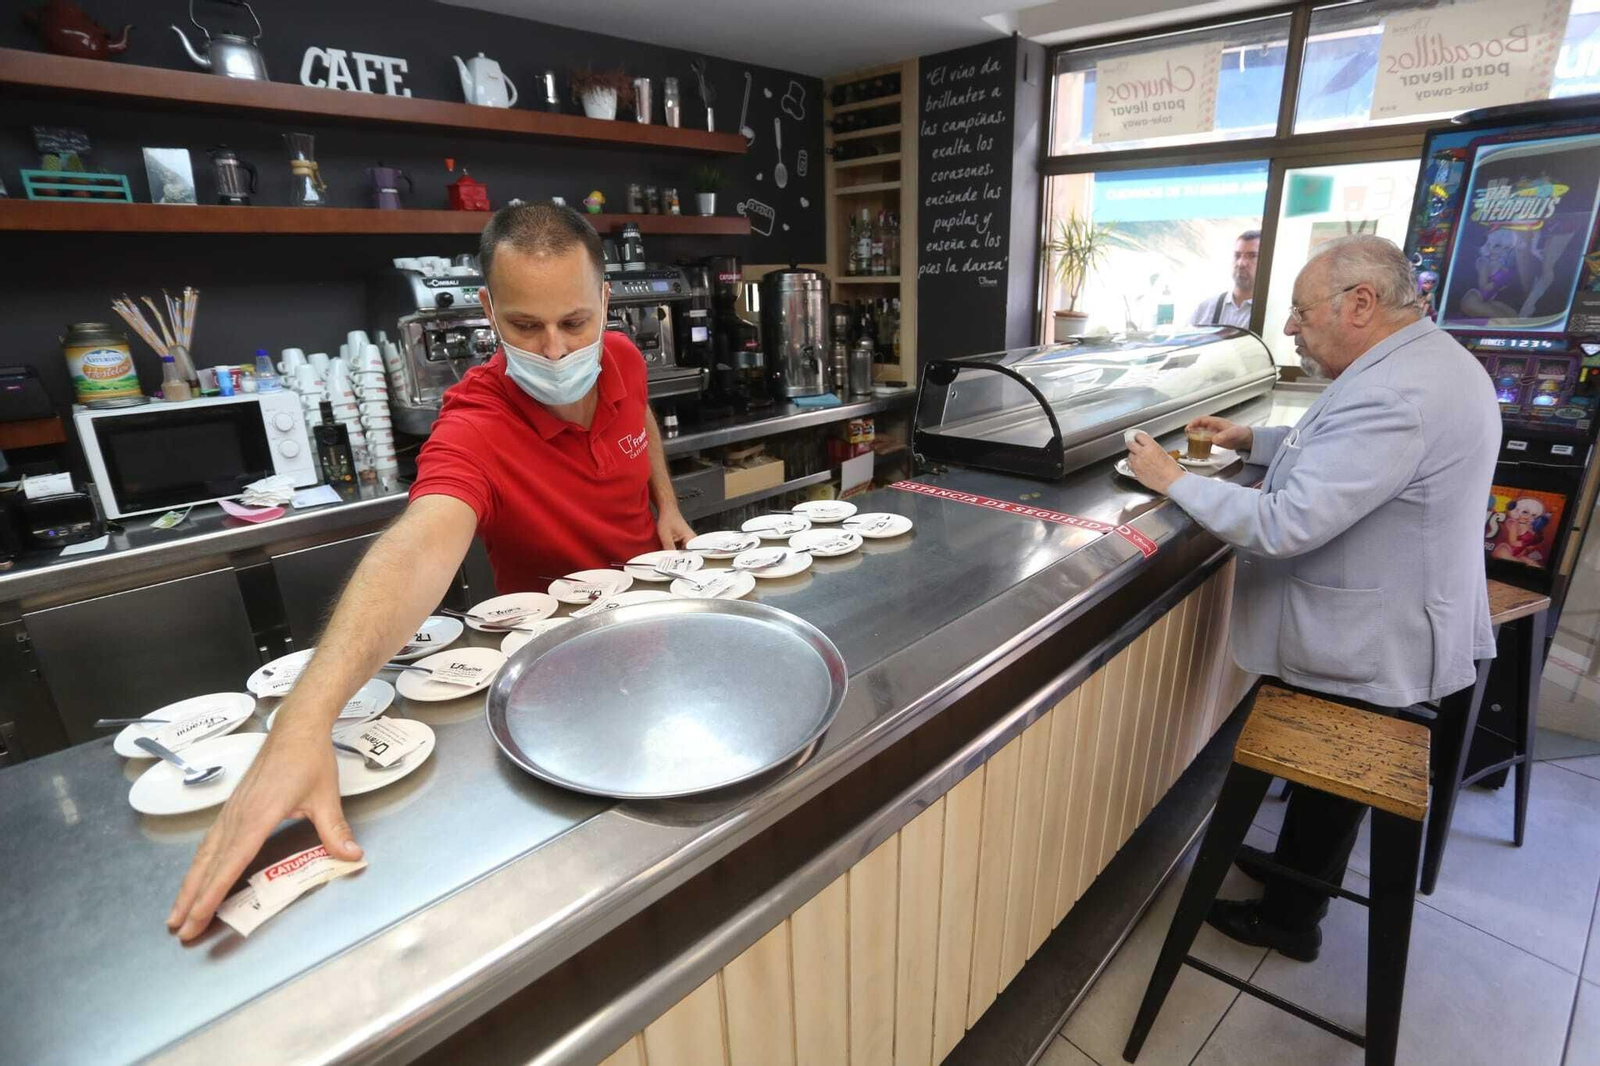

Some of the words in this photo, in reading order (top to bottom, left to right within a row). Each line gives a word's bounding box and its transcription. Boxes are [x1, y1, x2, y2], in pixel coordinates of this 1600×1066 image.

[300, 46, 411, 98] CAFE
[950, 64, 976, 81] vino
[980, 56, 1001, 74] da
[925, 86, 986, 112] brillantez
[991, 87, 1002, 97] a
[921, 120, 938, 136] las
[932, 138, 971, 159] exalta
[977, 134, 993, 151] los
[925, 186, 978, 206] enciende
[983, 182, 1002, 199] las
[1477, 197, 1560, 221] NEOPOLIS
[932, 209, 979, 233] pupilas
[976, 212, 993, 234] y
[926, 239, 966, 252] enseña
[970, 239, 980, 248] a
[984, 231, 1001, 248] los
[917, 263, 941, 279] pies
[945, 257, 958, 273] la
[1510, 339, 1517, 347] 1
[1531, 340, 1541, 348] 3
[891, 481, 978, 502] DISTANCIA
[981, 500, 1012, 509] DE
[1012, 505, 1132, 536] SEGURIDAD
